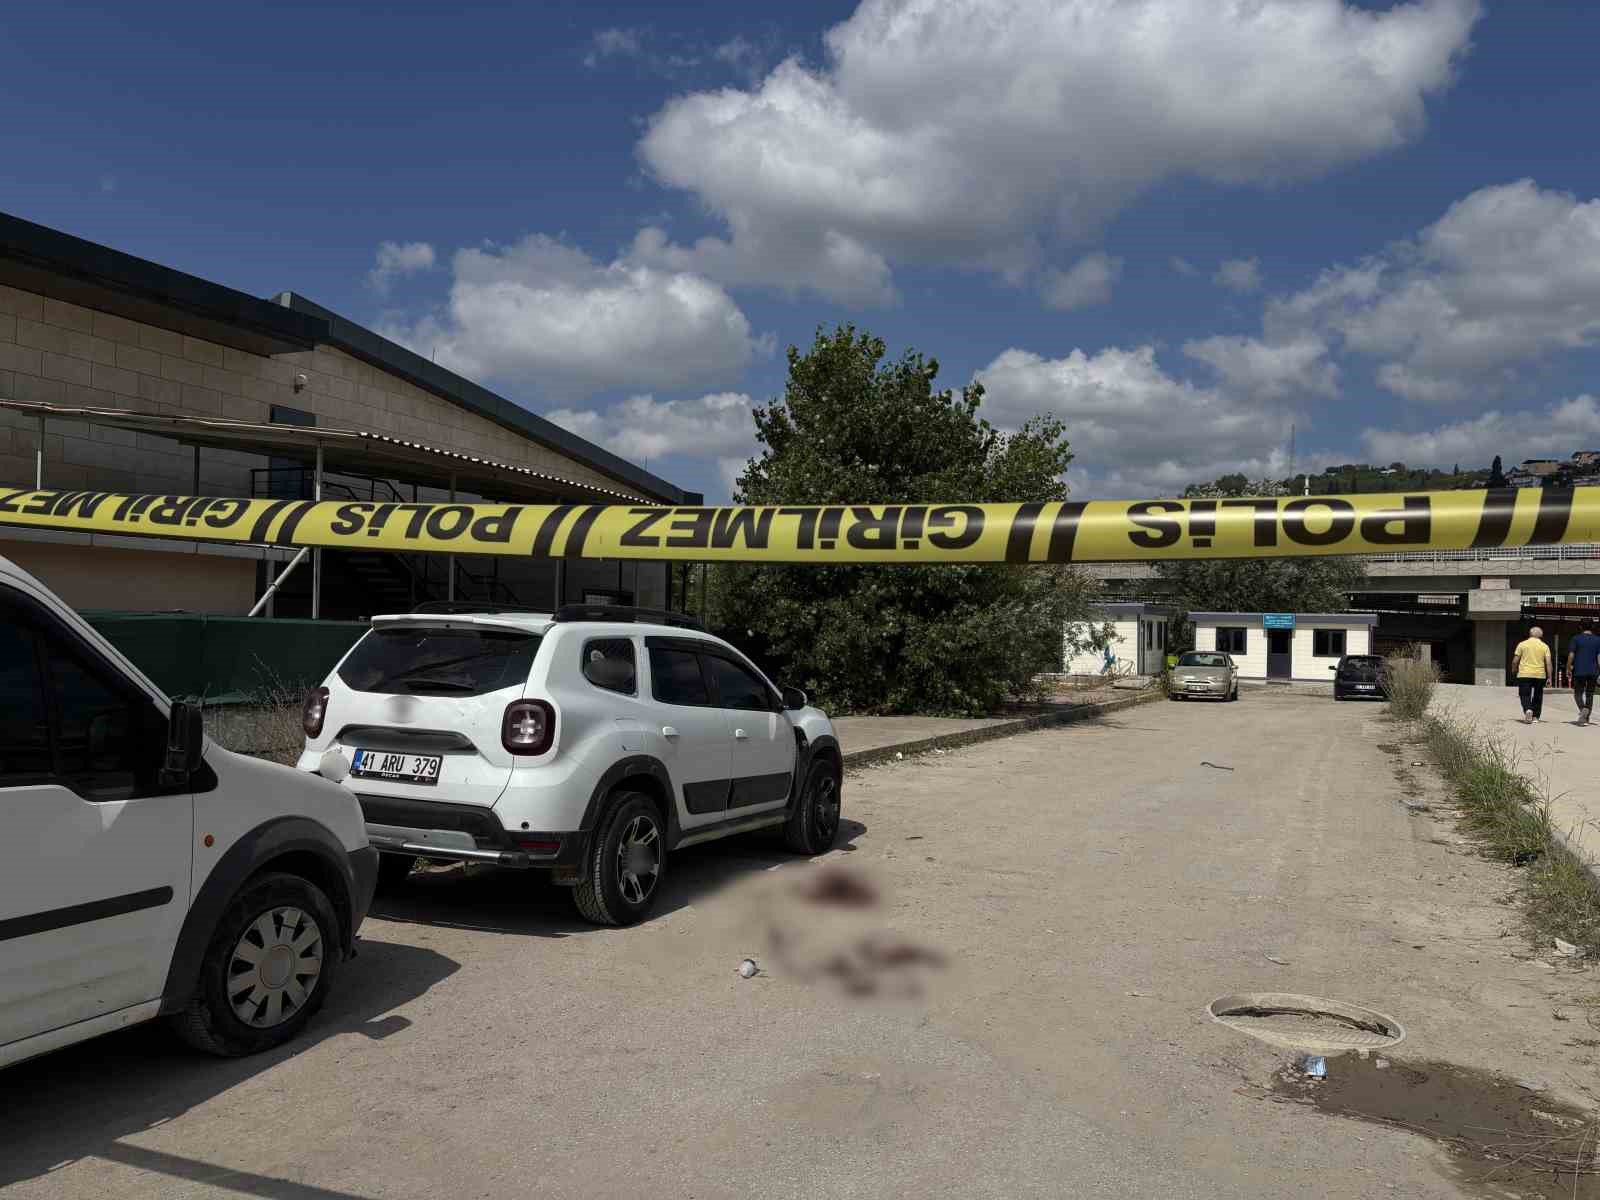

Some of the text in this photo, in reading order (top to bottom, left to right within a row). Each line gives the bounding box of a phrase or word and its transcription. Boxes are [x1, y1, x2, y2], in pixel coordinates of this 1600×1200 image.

[330, 503, 525, 544] POLİS
[620, 505, 985, 550] GİRİLMEZ
[1127, 496, 1431, 548] POLİS
[361, 753, 438, 776] 41 ARU 379
